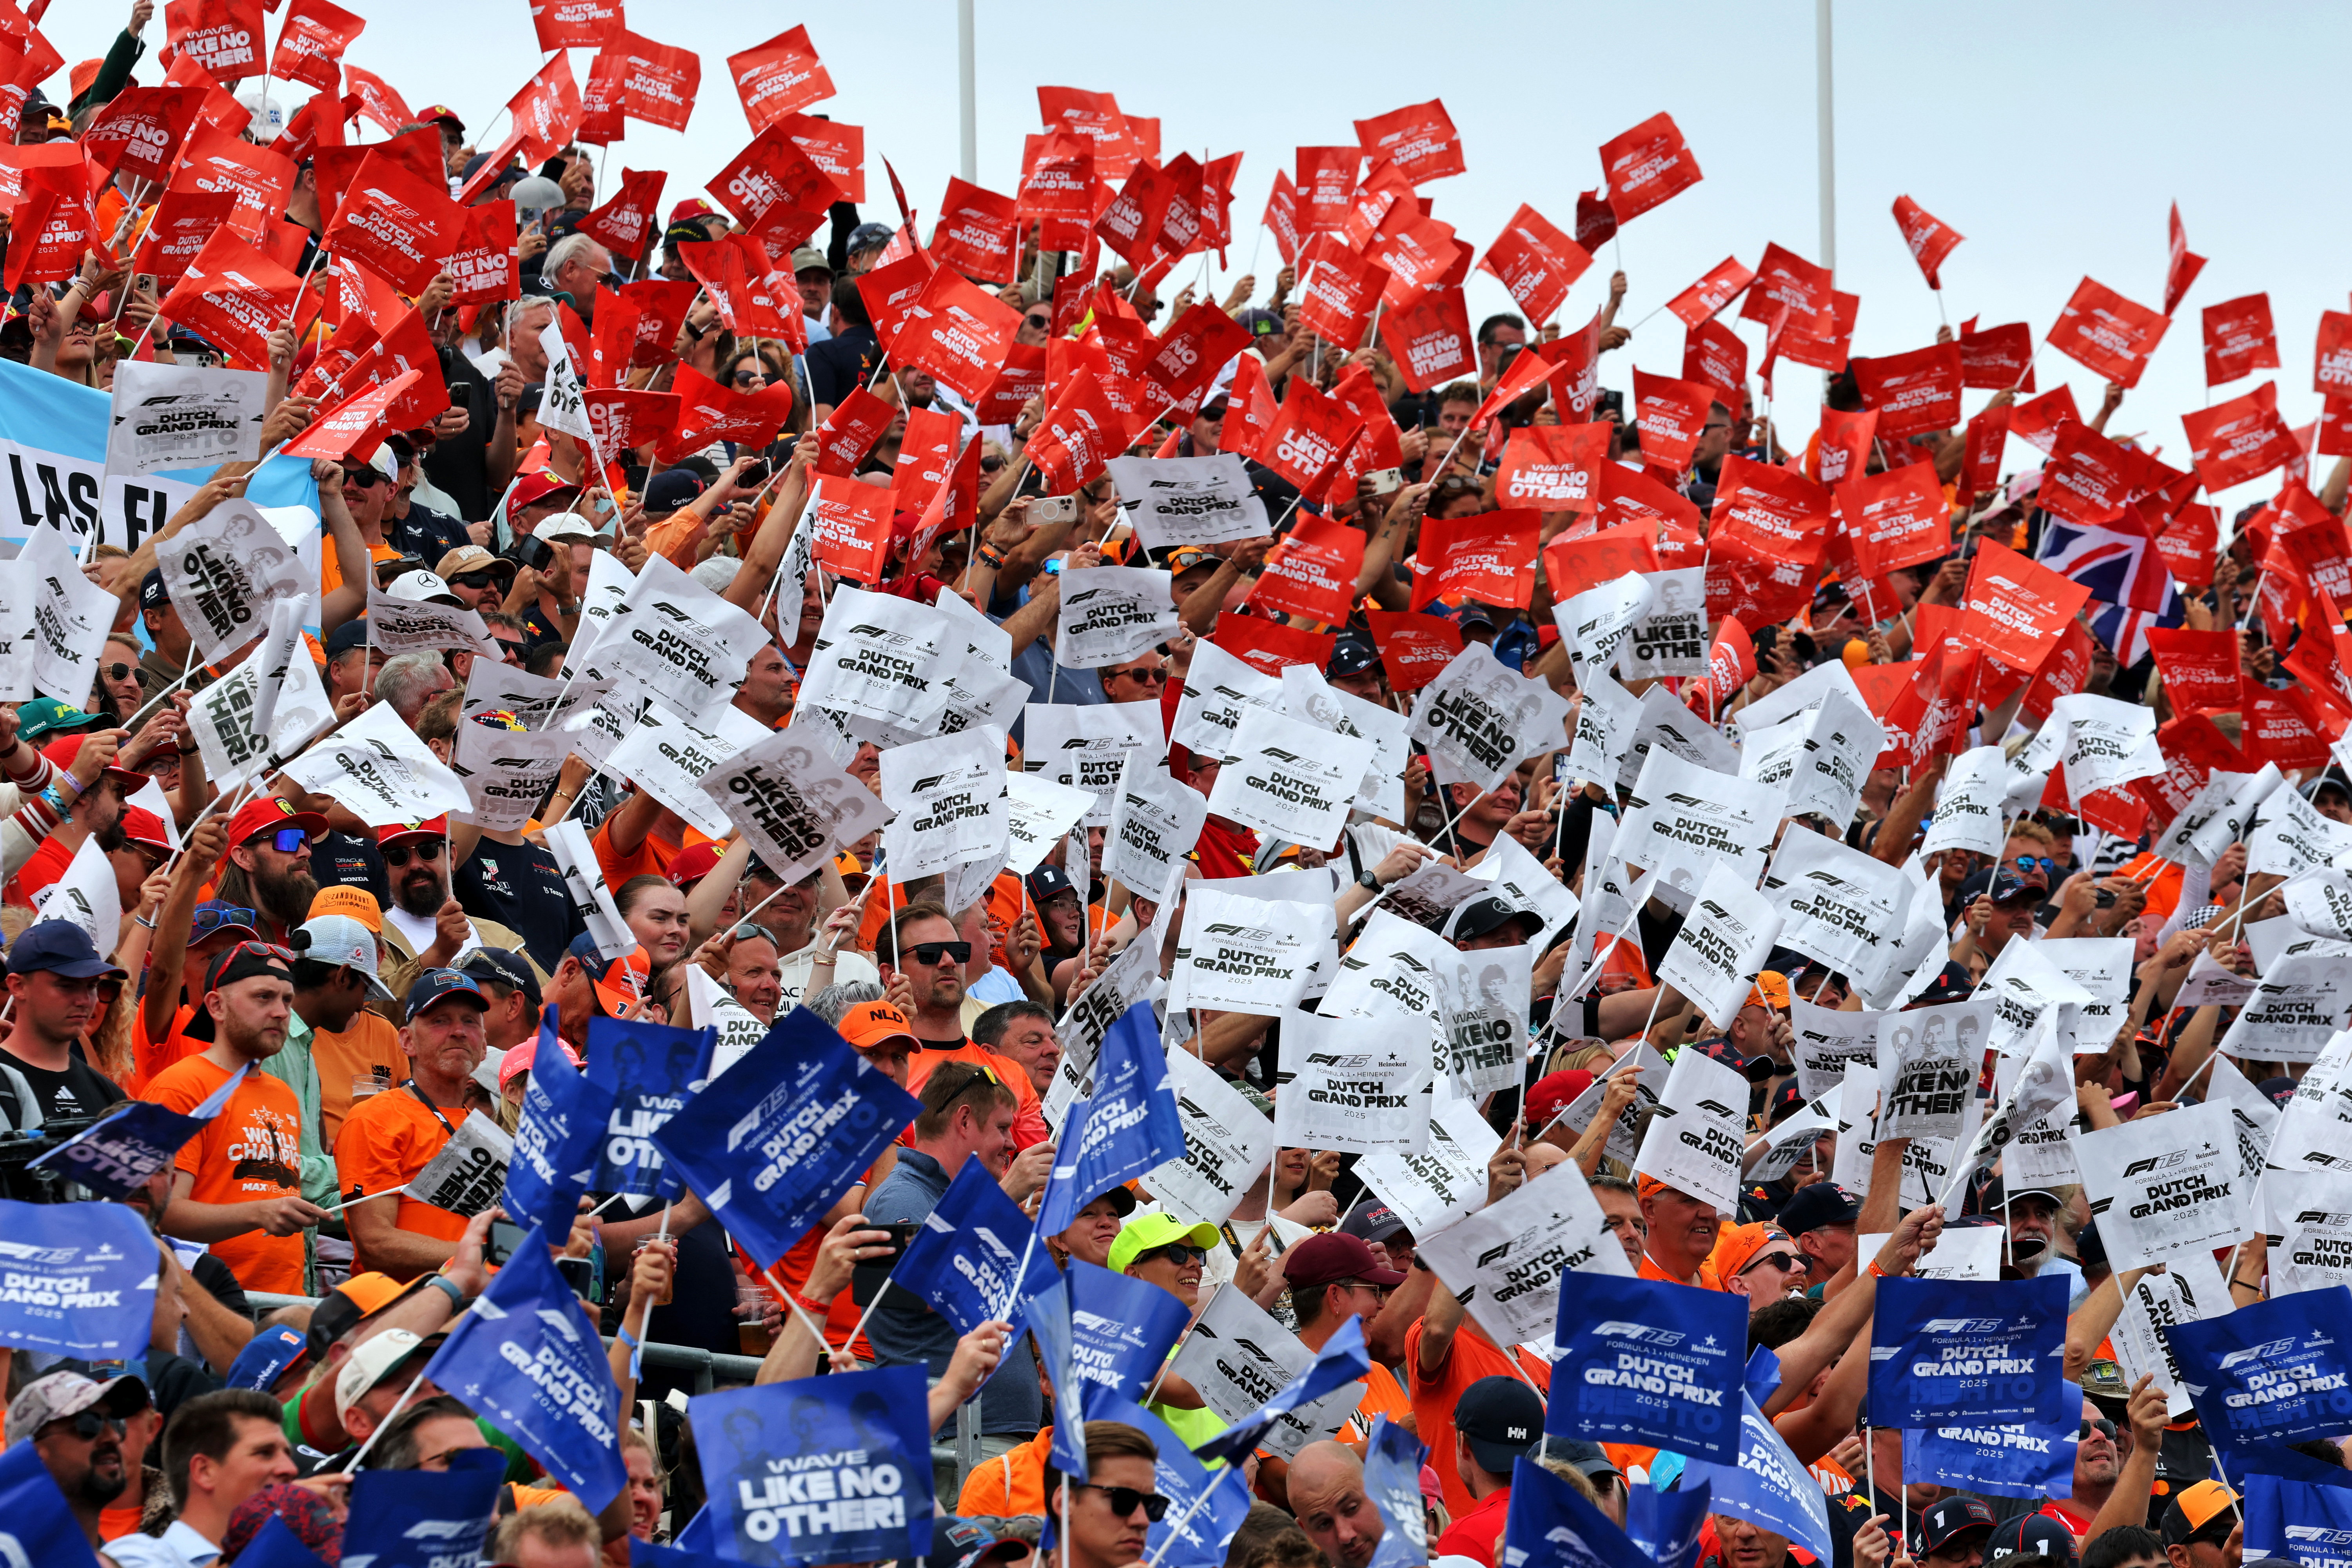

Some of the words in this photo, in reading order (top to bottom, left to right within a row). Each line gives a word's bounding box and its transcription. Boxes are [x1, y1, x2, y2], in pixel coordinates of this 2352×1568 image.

[554, 11, 589, 22] GRAND
[590, 8, 614, 19] PRIX
[561, 2, 597, 14] DUTCH
[221, 30, 250, 50] NO
[634, 73, 672, 92] DUTCH
[747, 84, 784, 107] GRAND
[784, 71, 811, 89] PRIX
[756, 71, 794, 92] DUTCH
[262, 178, 282, 190] Heineken
[762, 169, 793, 204] WAVE
[368, 211, 415, 245] DUTCH
[367, 235, 388, 250] 2025
[225, 291, 270, 326] DUTCH
[227, 317, 247, 334] 2025
[932, 329, 962, 354] GRAND
[961, 348, 987, 370] PRIX
[946, 326, 981, 352] DUTCH
[160, 411, 216, 424] DUTCH
[340, 411, 368, 421] DUTCH
[136, 421, 195, 436] GRAND
[198, 419, 238, 429] PRIX
[1511, 470, 1560, 485] LIKE
[1562, 471, 1589, 486] NO
[8, 454, 105, 545] LAS
[1509, 483, 1588, 500] OTHER!
[1747, 506, 1791, 529] DUTCH
[1869, 524, 1906, 544] GRAND
[1902, 517, 1935, 533] PRIX
[840, 537, 874, 552] PRIX
[1283, 558, 1327, 577] DUTCH
[1452, 554, 1498, 567] DUTCH
[225, 552, 256, 601] WAVE
[1308, 577, 1341, 592] PRIX
[183, 552, 236, 642] OTHER!
[1086, 602, 1138, 620] DUTCH
[1989, 595, 2035, 624] DUTCH
[45, 604, 66, 642] DUTCH
[1069, 618, 1122, 635] GRAND
[1123, 612, 1157, 624] PRIX
[1632, 624, 1687, 644] LIKE
[657, 628, 711, 666] DUTCH
[854, 637, 884, 650] FORMULA
[895, 649, 927, 662] HEINEKEN
[631, 628, 686, 667] GRAND
[685, 662, 719, 690] PRIX
[858, 650, 915, 673] DUTCH
[837, 658, 892, 680] GRAND
[893, 672, 930, 692] PRIX
[1461, 688, 1510, 728] WAVE
[25, 721, 47, 735] kimoa
[1426, 708, 1507, 773] OTHER!
[2078, 737, 2120, 751] DUTCH
[680, 774, 699, 789] 2025
[967, 769, 989, 779] Heineken
[1270, 771, 1321, 797] DUTCH
[932, 792, 971, 815] DUTCH
[1245, 775, 1300, 804] GRAND
[1300, 797, 1333, 813] PRIX
[729, 775, 810, 862] OTHER!
[1958, 803, 1989, 815] PRIX
[2287, 791, 2329, 834] FORZA
[1125, 817, 1161, 845] DUTCH
[1652, 820, 1706, 846] GRAND
[1707, 840, 1746, 857] PRIX
[1675, 817, 1729, 839] DUTCH
[1143, 842, 1171, 864] PRIX
[332, 892, 370, 905] ZANDVOORT
[549, 887, 564, 898] Tezos
[1814, 895, 1867, 925] DUTCH
[1790, 899, 1843, 926] GRAND
[1843, 919, 1880, 946] PRIX
[1698, 926, 1739, 962] DUTCH
[1217, 947, 1276, 967] DUTCH
[1697, 959, 1717, 977] 2025
[1193, 957, 1253, 976] GRAND
[1254, 965, 1294, 980] PRIX
[616, 1002, 628, 1016] 1
[869, 1009, 904, 1024] NLD
[1452, 1008, 1489, 1024] WAVE
[2245, 1012, 2296, 1025] GRAND
[2298, 1014, 2334, 1026] PRIX
[2266, 1003, 2315, 1013] DUTCH
[1316, 1067, 1345, 1077] FORMULA
[1904, 1059, 1960, 1071] WAVE
[1327, 1079, 1384, 1094] DUTCH
[1308, 1089, 1362, 1108] GRAND
[1364, 1094, 1408, 1108] PRIX
[1108, 1100, 1149, 1131] PRIX
[753, 1138, 816, 1192] GRAND
[809, 1089, 861, 1139] PRIX
[762, 1098, 826, 1161] DUTCH
[1169, 1158, 1192, 1180] 2025
[1196, 1158, 1235, 1198] PRIX
[1464, 1165, 1484, 1187] Heineken
[1710, 1161, 1735, 1177] 2025
[242, 1182, 266, 1192] MAX
[1425, 1176, 1457, 1207] PRIX
[2147, 1174, 2207, 1200] DUTCH
[2130, 1193, 2191, 1219] GRAND
[2192, 1182, 2232, 1204] PRIX
[1222, 1226, 1237, 1247] Nikon
[1506, 1245, 1566, 1283] DUTCH
[3, 1272, 90, 1294] DUTCH
[2325, 1272, 2343, 1280] 2025
[66, 1289, 122, 1308] PRIX
[279, 1331, 301, 1345] 1
[2143, 1327, 2156, 1353] 2025
[1941, 1344, 2008, 1361] DUTCH
[535, 1345, 604, 1412] DUTCH
[1617, 1354, 1695, 1384] DUTCH
[1913, 1361, 1984, 1377] GRAND
[1987, 1359, 2034, 1375] PRIX
[2247, 1363, 2318, 1390] DUTCH
[499, 1341, 571, 1406] GRAND
[566, 1402, 615, 1450] PRIX
[1584, 1366, 1667, 1396] GRAND
[1668, 1379, 1723, 1407] PRIX
[2225, 1382, 2299, 1407] GRAND
[2300, 1372, 2349, 1394] PRIX
[1508, 1426, 1527, 1440] HH
[2003, 1434, 2050, 1454] PRIX
[1975, 1447, 2004, 1459] 2025
[744, 1496, 906, 1541] OTHER!
[1933, 1510, 1945, 1530] 1
[2036, 1539, 2049, 1555] 1
